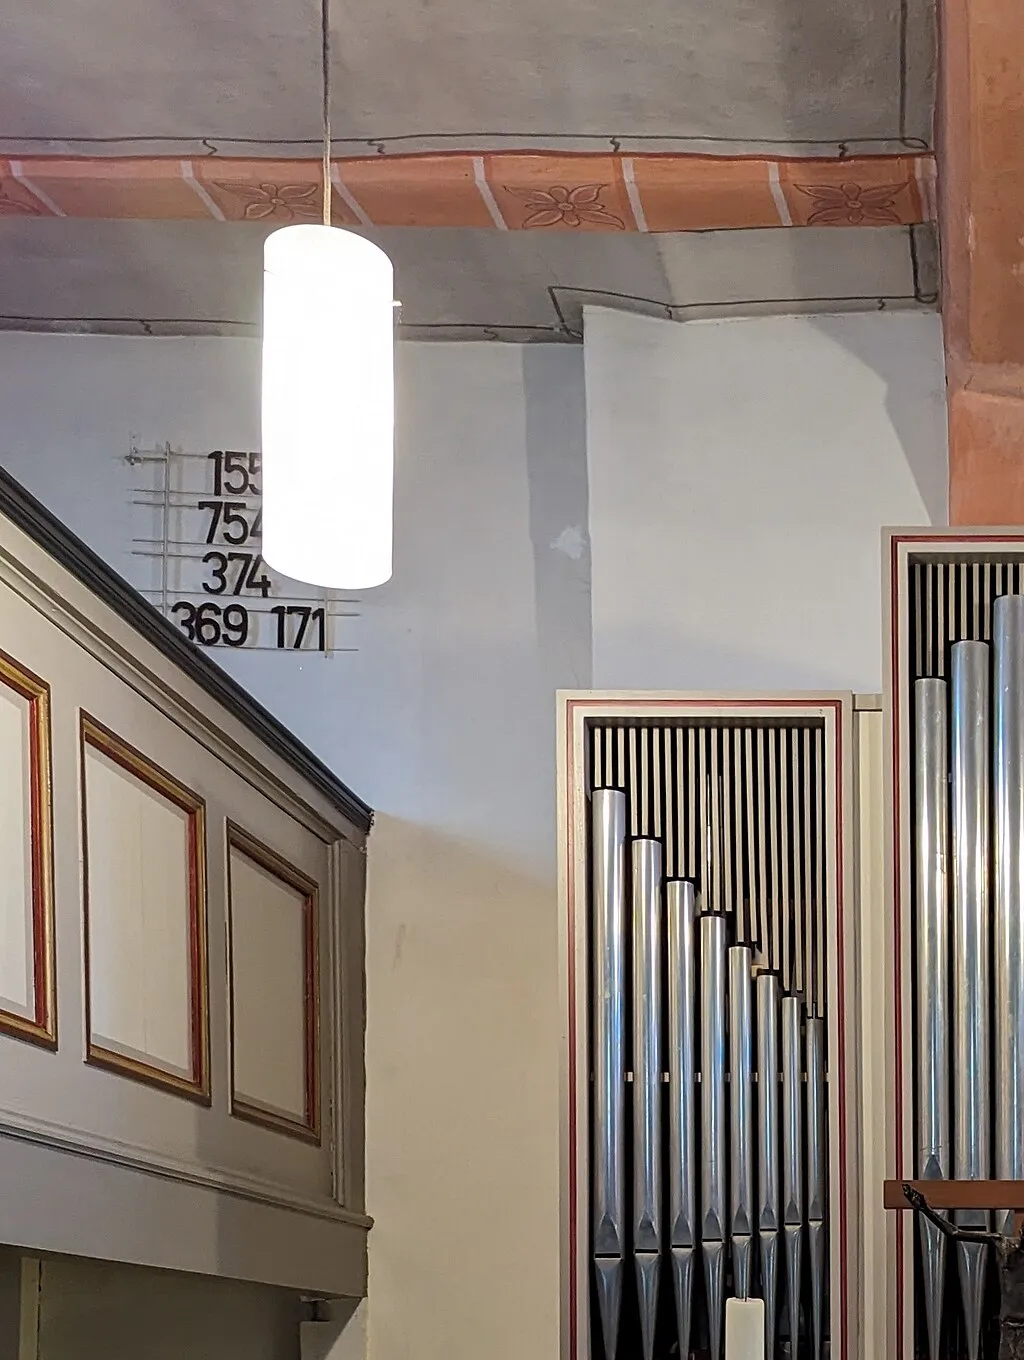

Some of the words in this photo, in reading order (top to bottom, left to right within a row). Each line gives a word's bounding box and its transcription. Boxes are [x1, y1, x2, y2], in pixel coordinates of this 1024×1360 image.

[202, 551, 271, 598] 374
[171, 601, 248, 647] 369
[271, 605, 325, 651] 171
